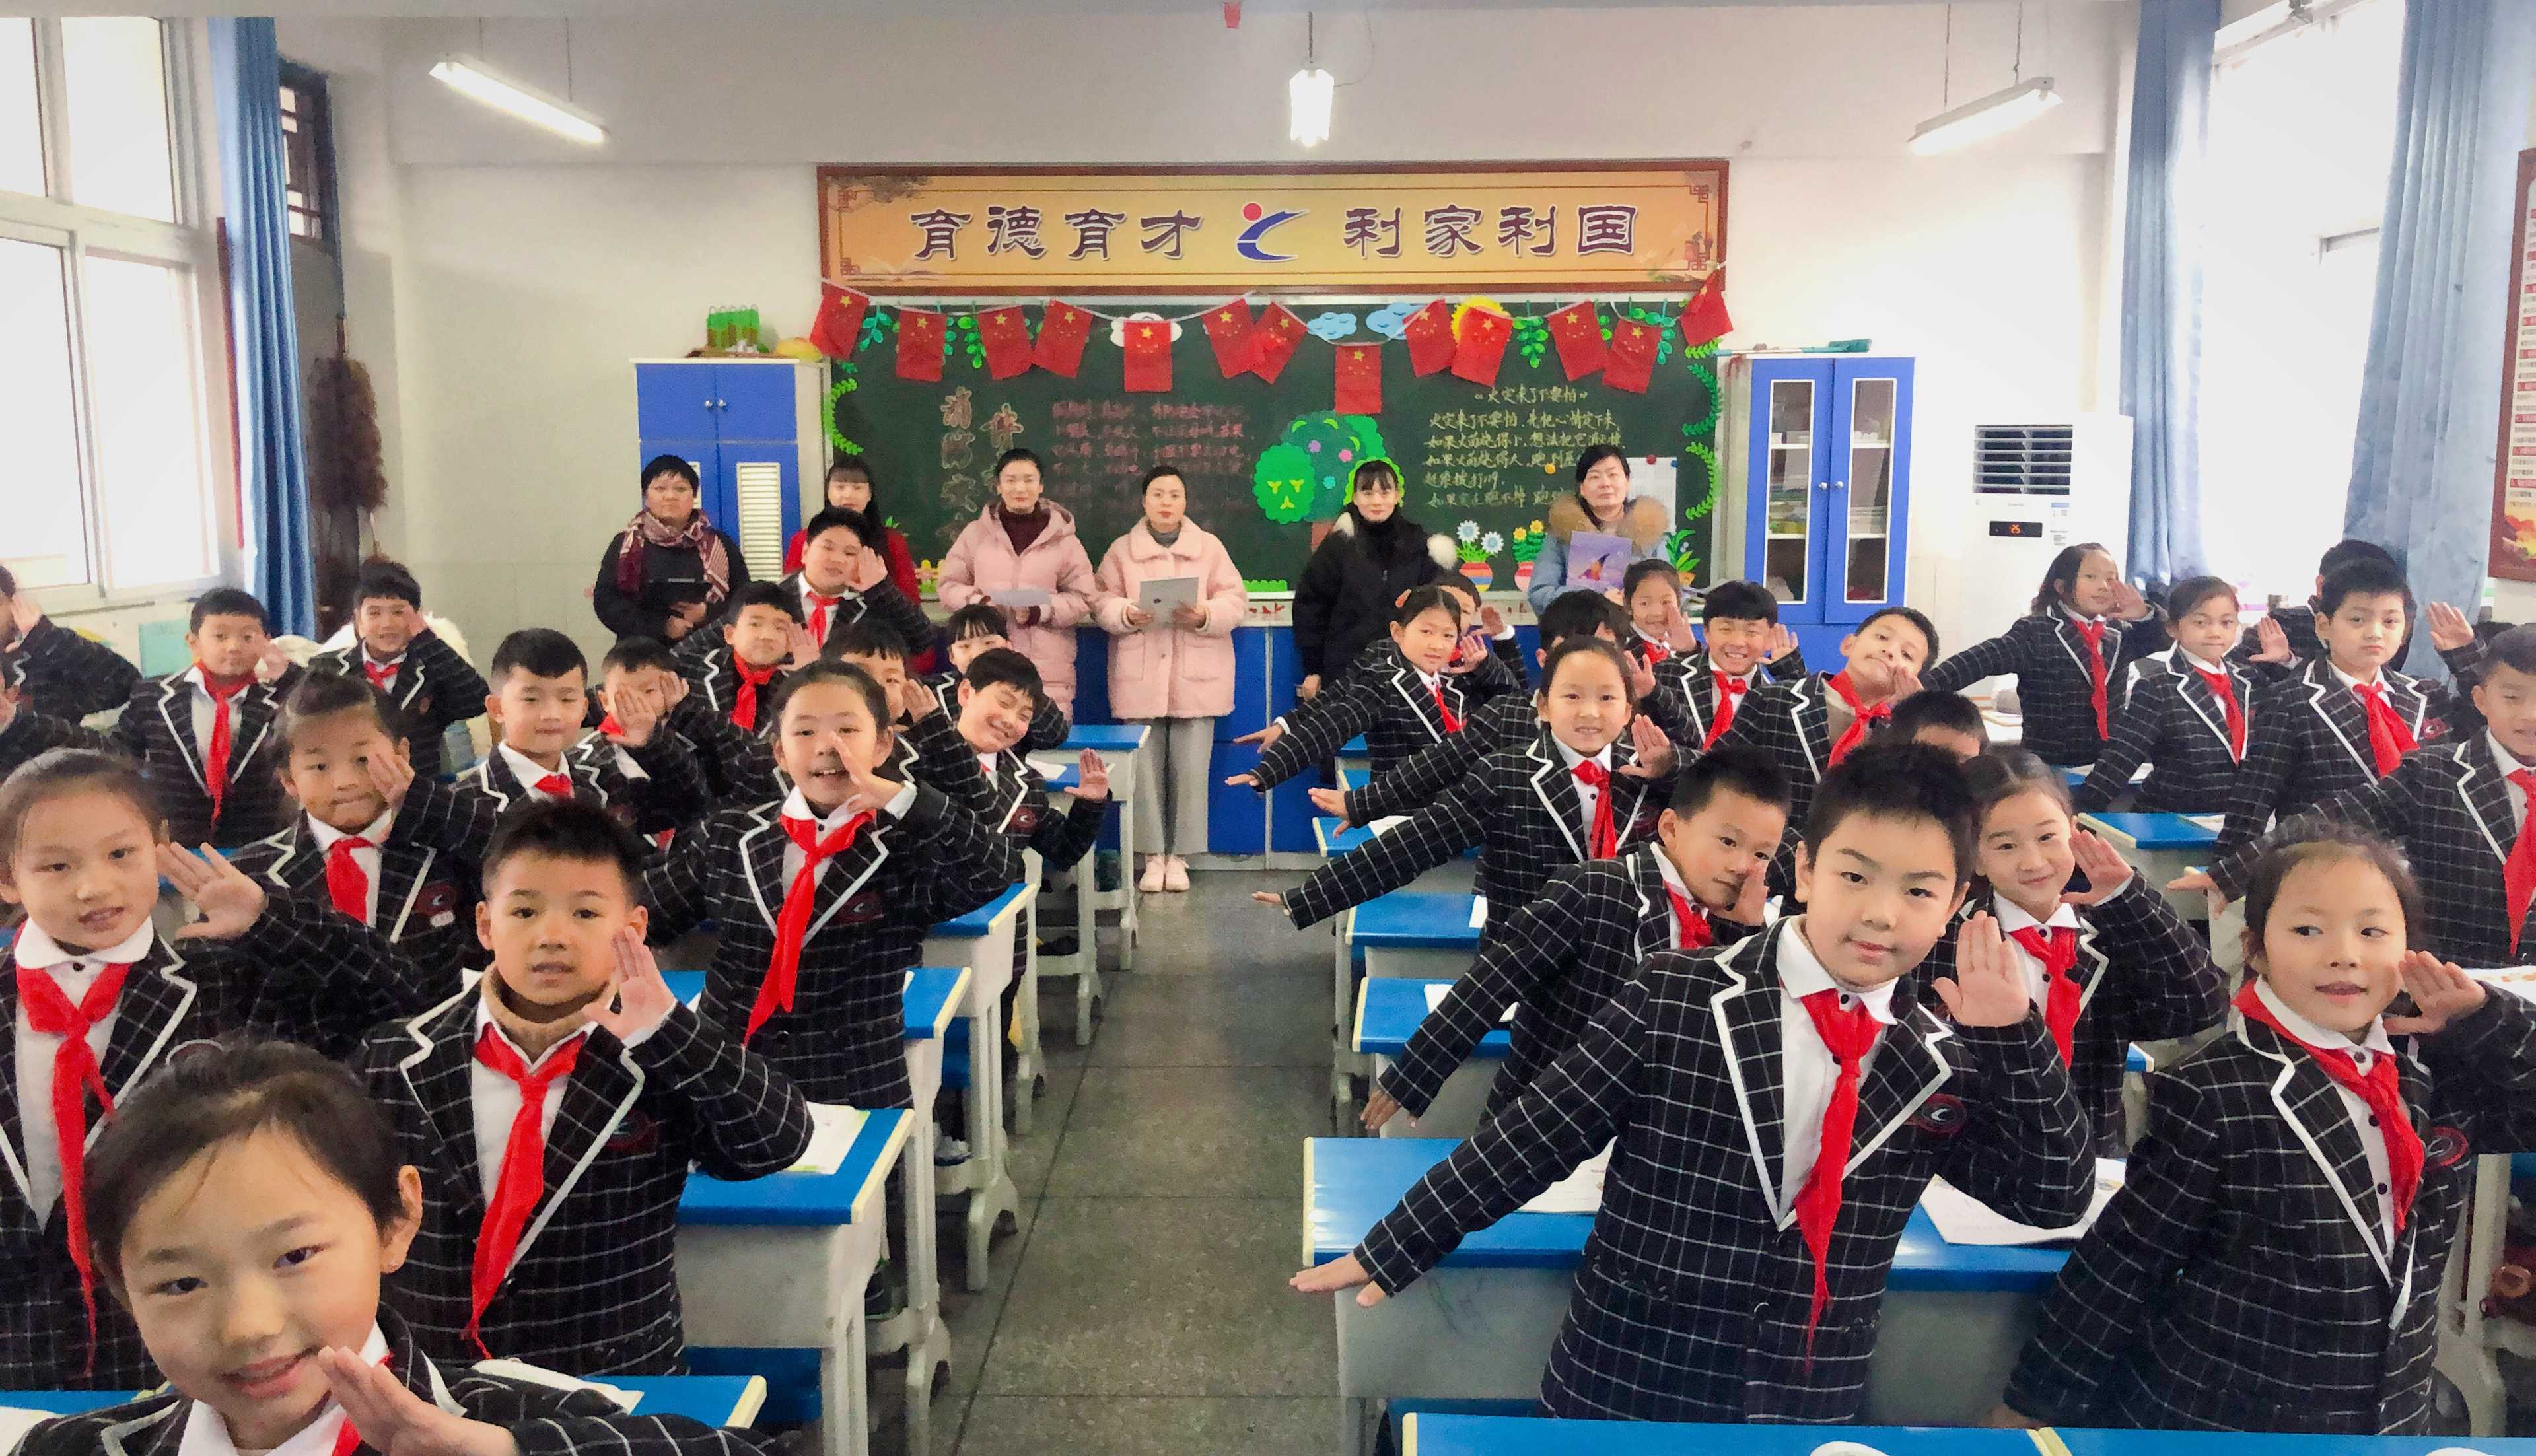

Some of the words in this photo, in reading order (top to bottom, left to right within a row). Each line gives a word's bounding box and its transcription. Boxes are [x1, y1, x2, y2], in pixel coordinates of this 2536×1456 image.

[911, 206, 1205, 260] 育德育才
[1345, 205, 1639, 256] 利家利国
